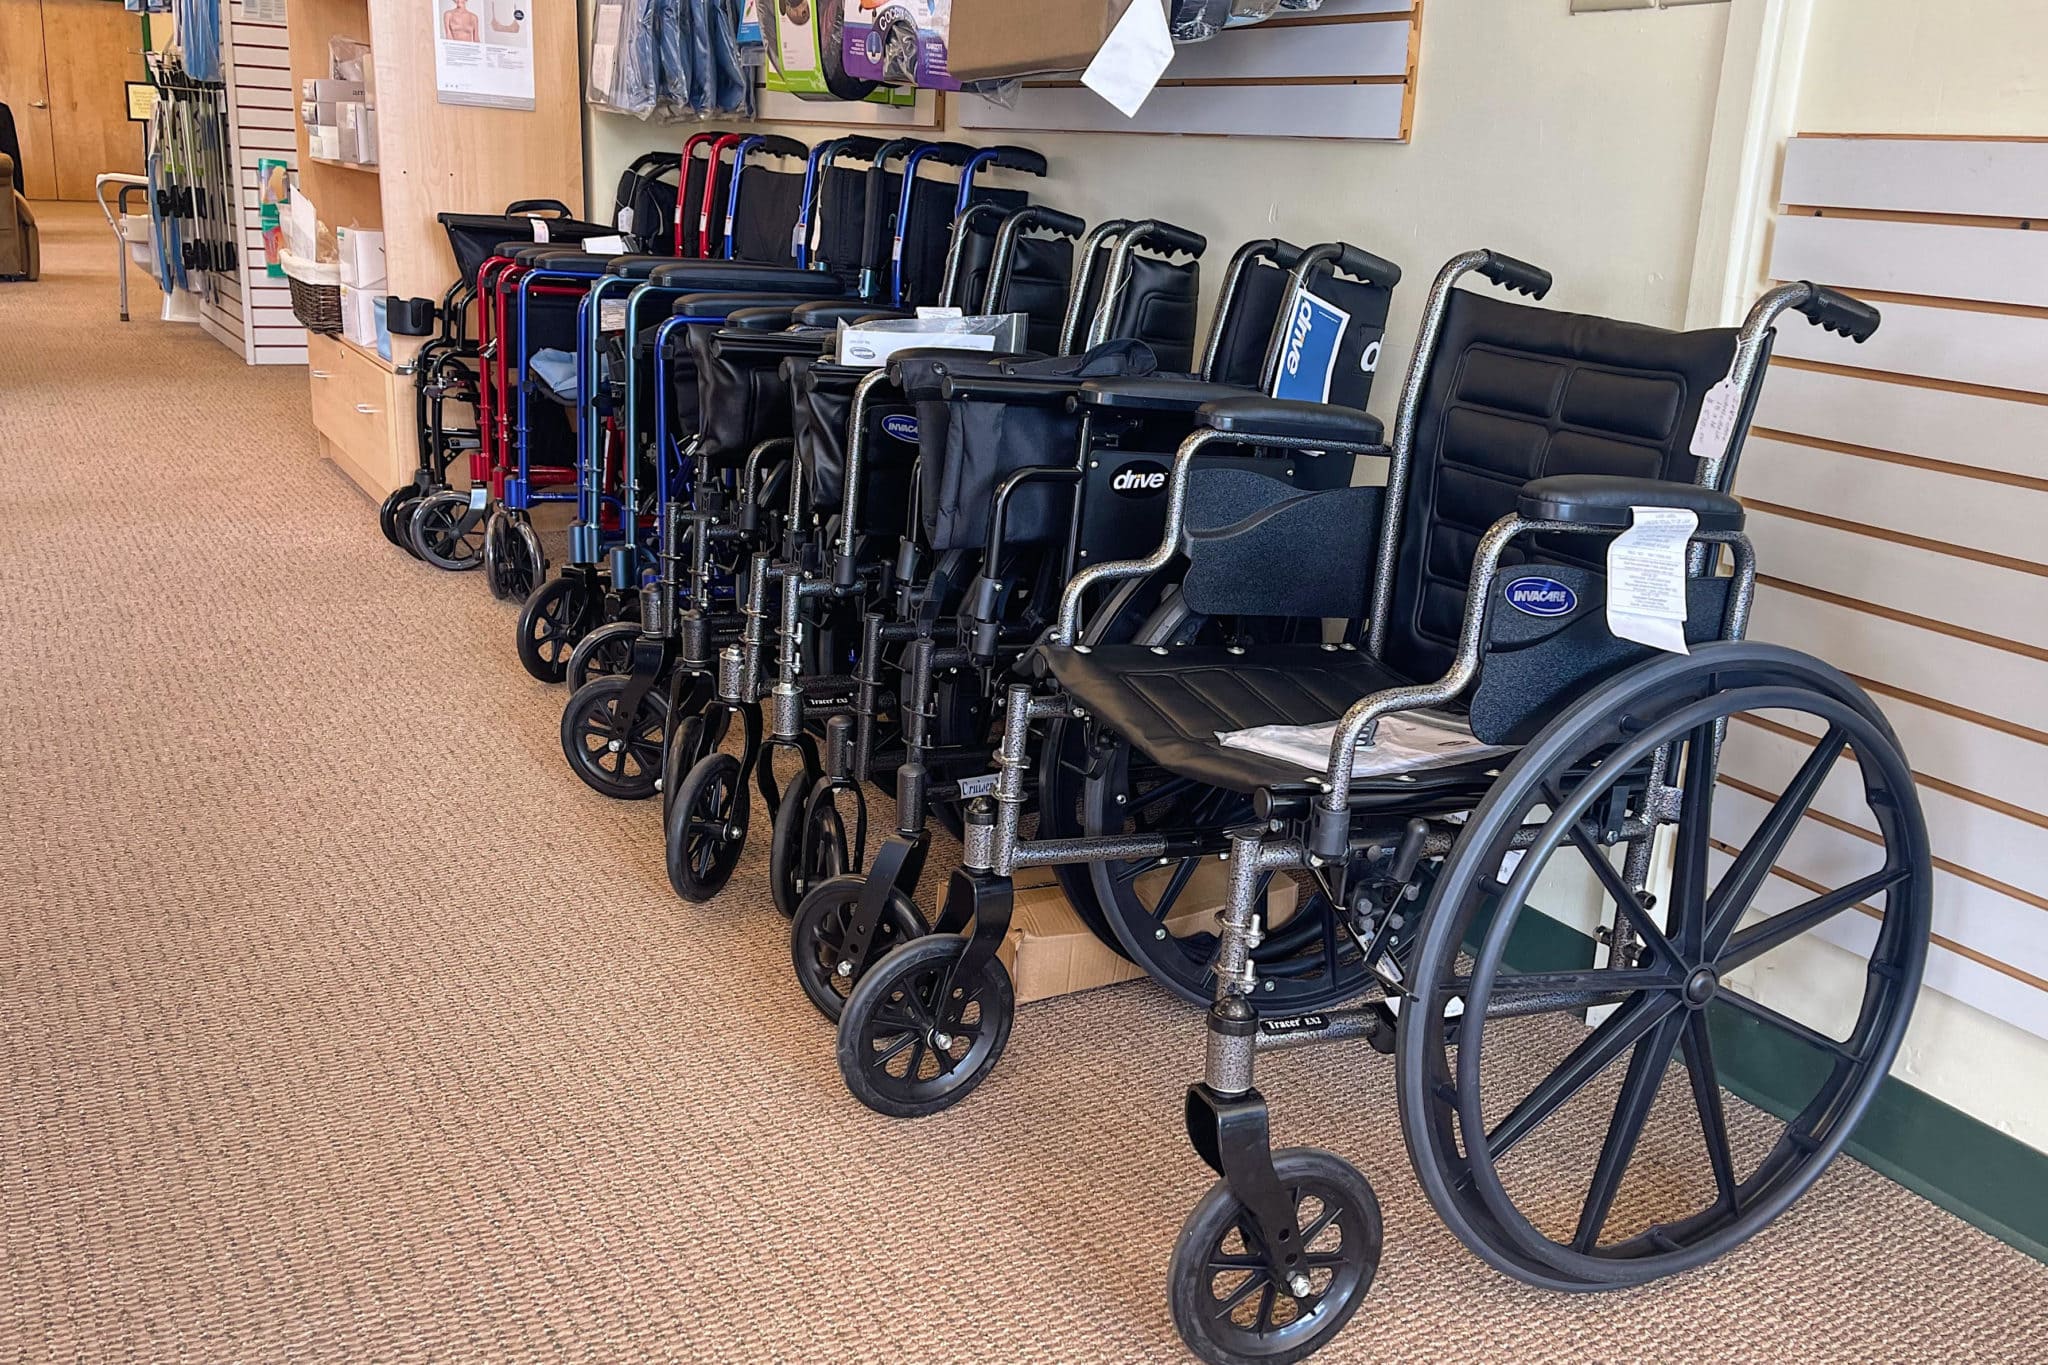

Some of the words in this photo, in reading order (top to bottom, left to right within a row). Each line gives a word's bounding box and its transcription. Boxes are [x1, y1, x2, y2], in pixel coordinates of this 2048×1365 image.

[1286, 300, 1313, 375] drive
[888, 422, 919, 434] INVACA
[1113, 469, 1166, 490] drive
[1513, 590, 1567, 603] INVACARE
[1264, 1017, 1301, 1030] Tracer
[1303, 1016, 1322, 1026] EX2
